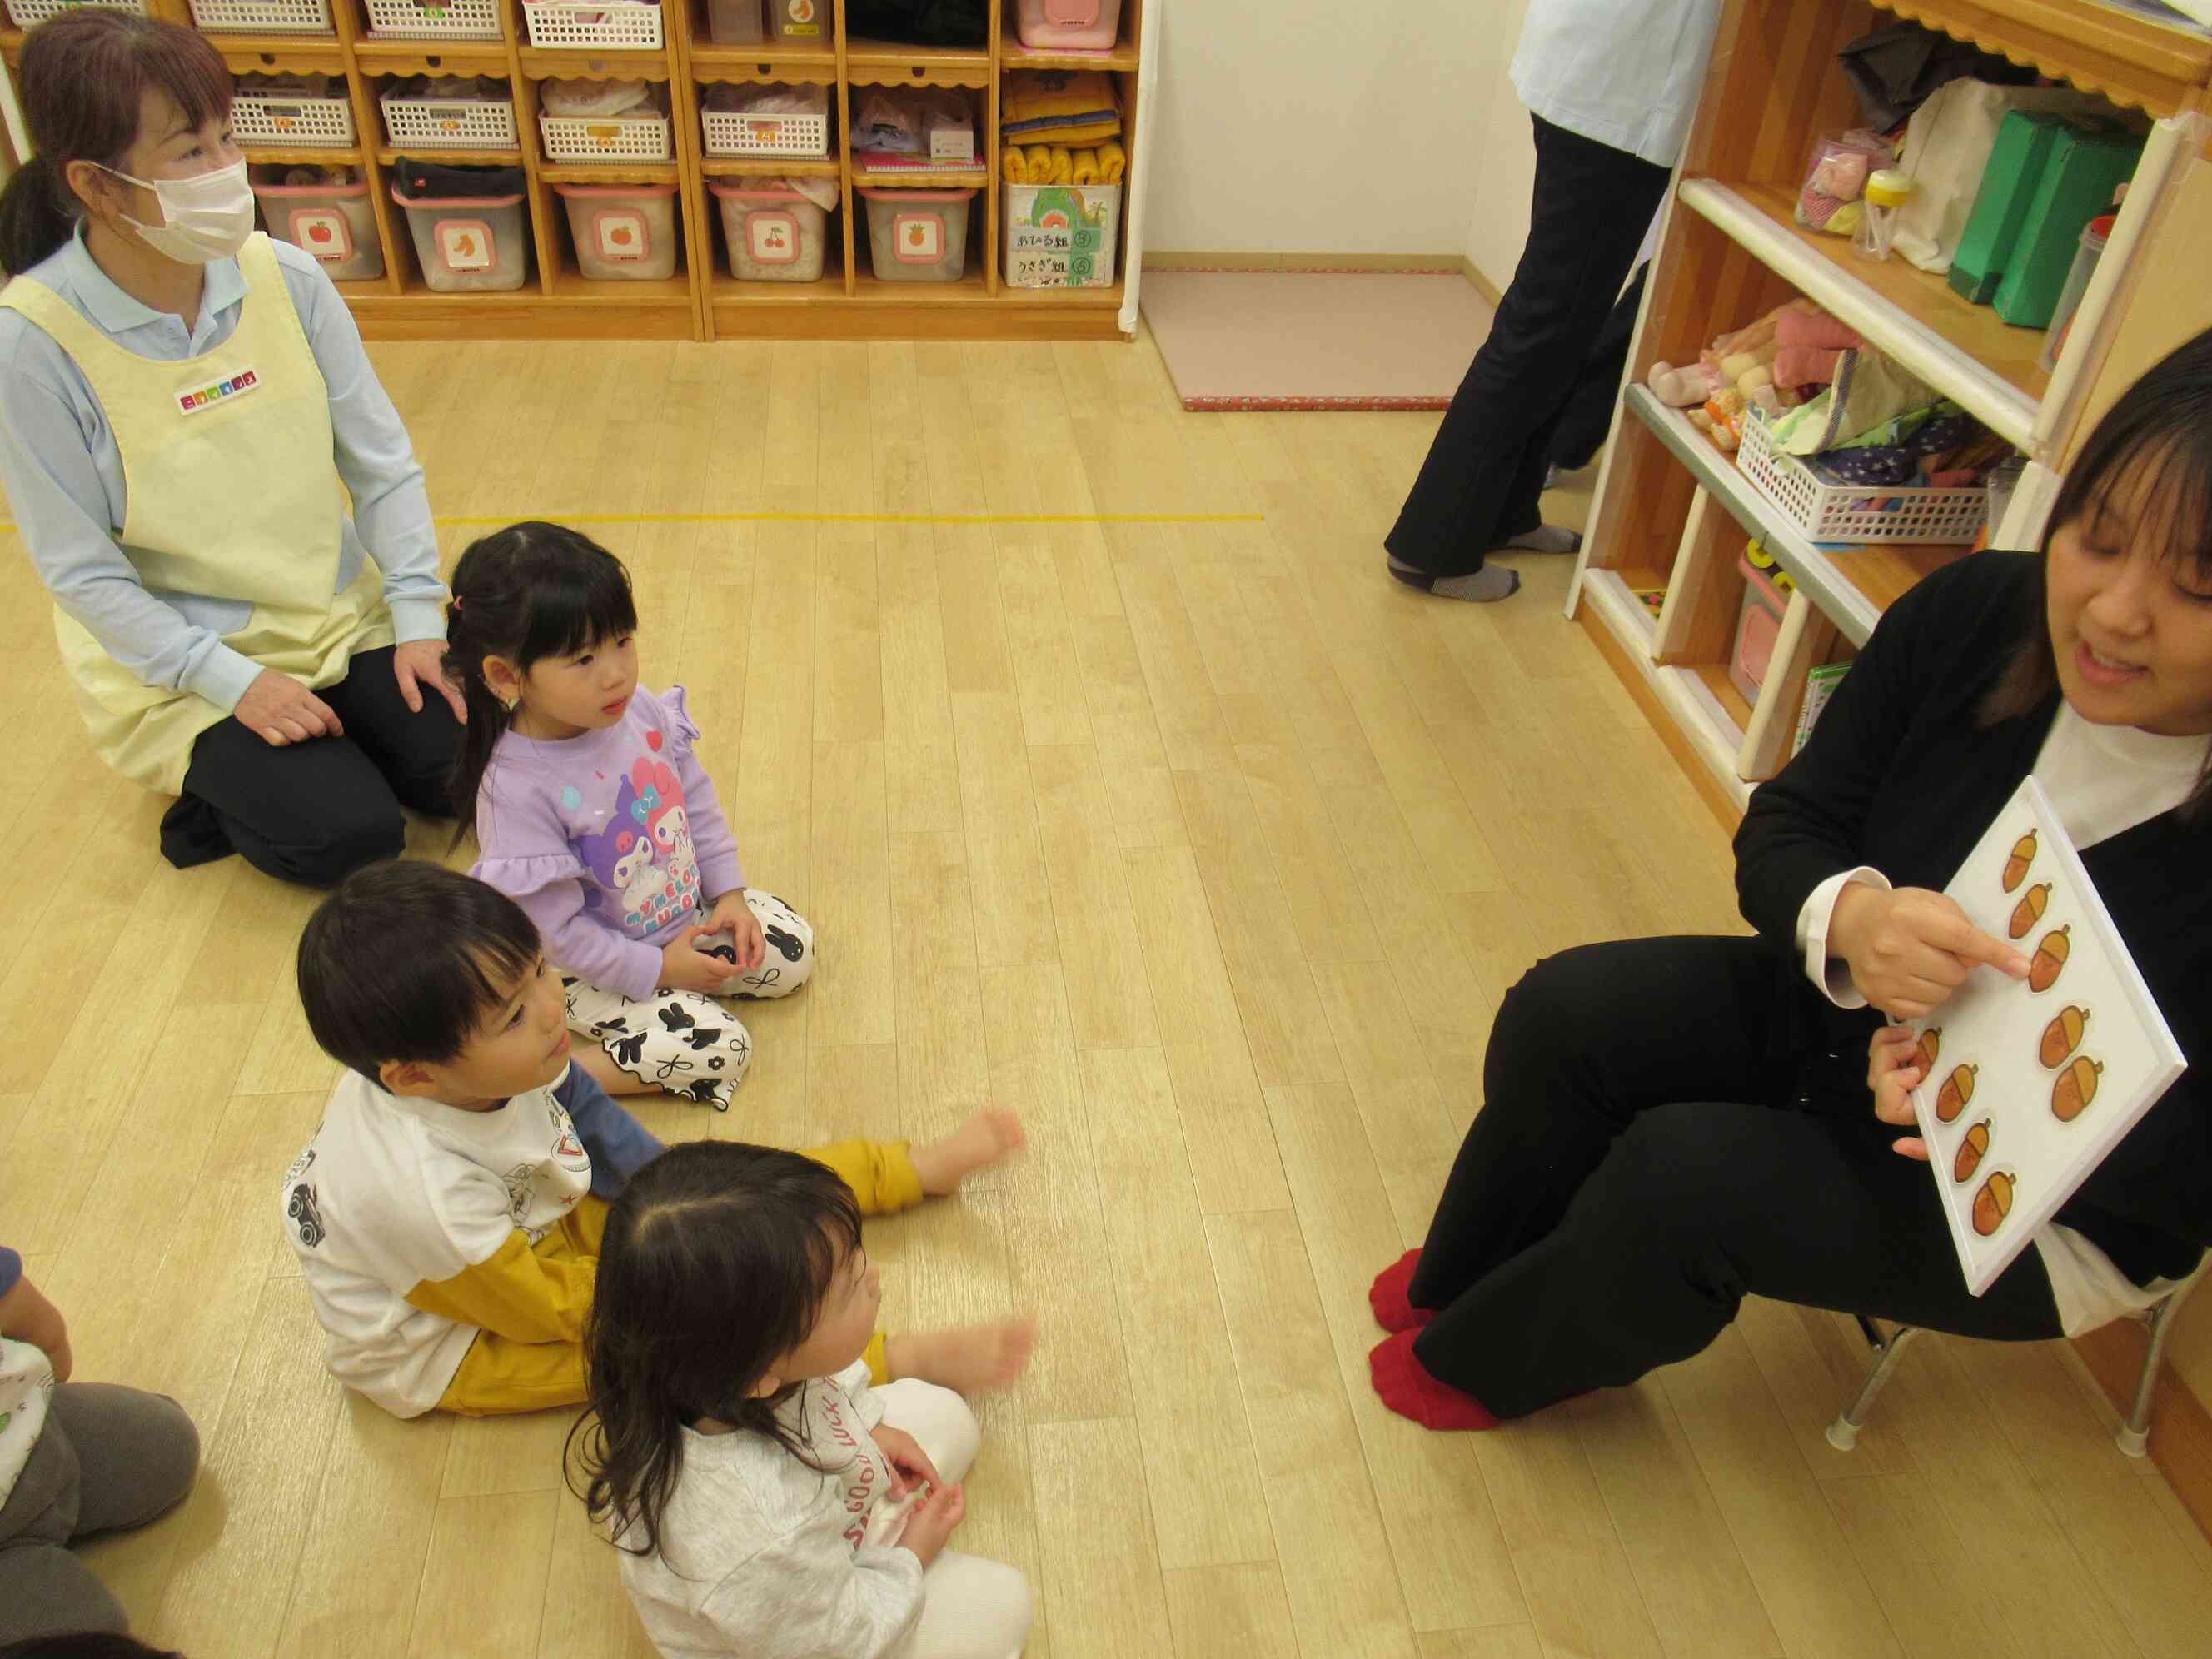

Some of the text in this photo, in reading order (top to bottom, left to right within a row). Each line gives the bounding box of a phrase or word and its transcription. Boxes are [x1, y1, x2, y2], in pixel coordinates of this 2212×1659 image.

[1017, 234, 1069, 249] あひる組
[1019, 257, 1069, 273] うさぎ組
[821, 1395, 858, 1447] LUCK
